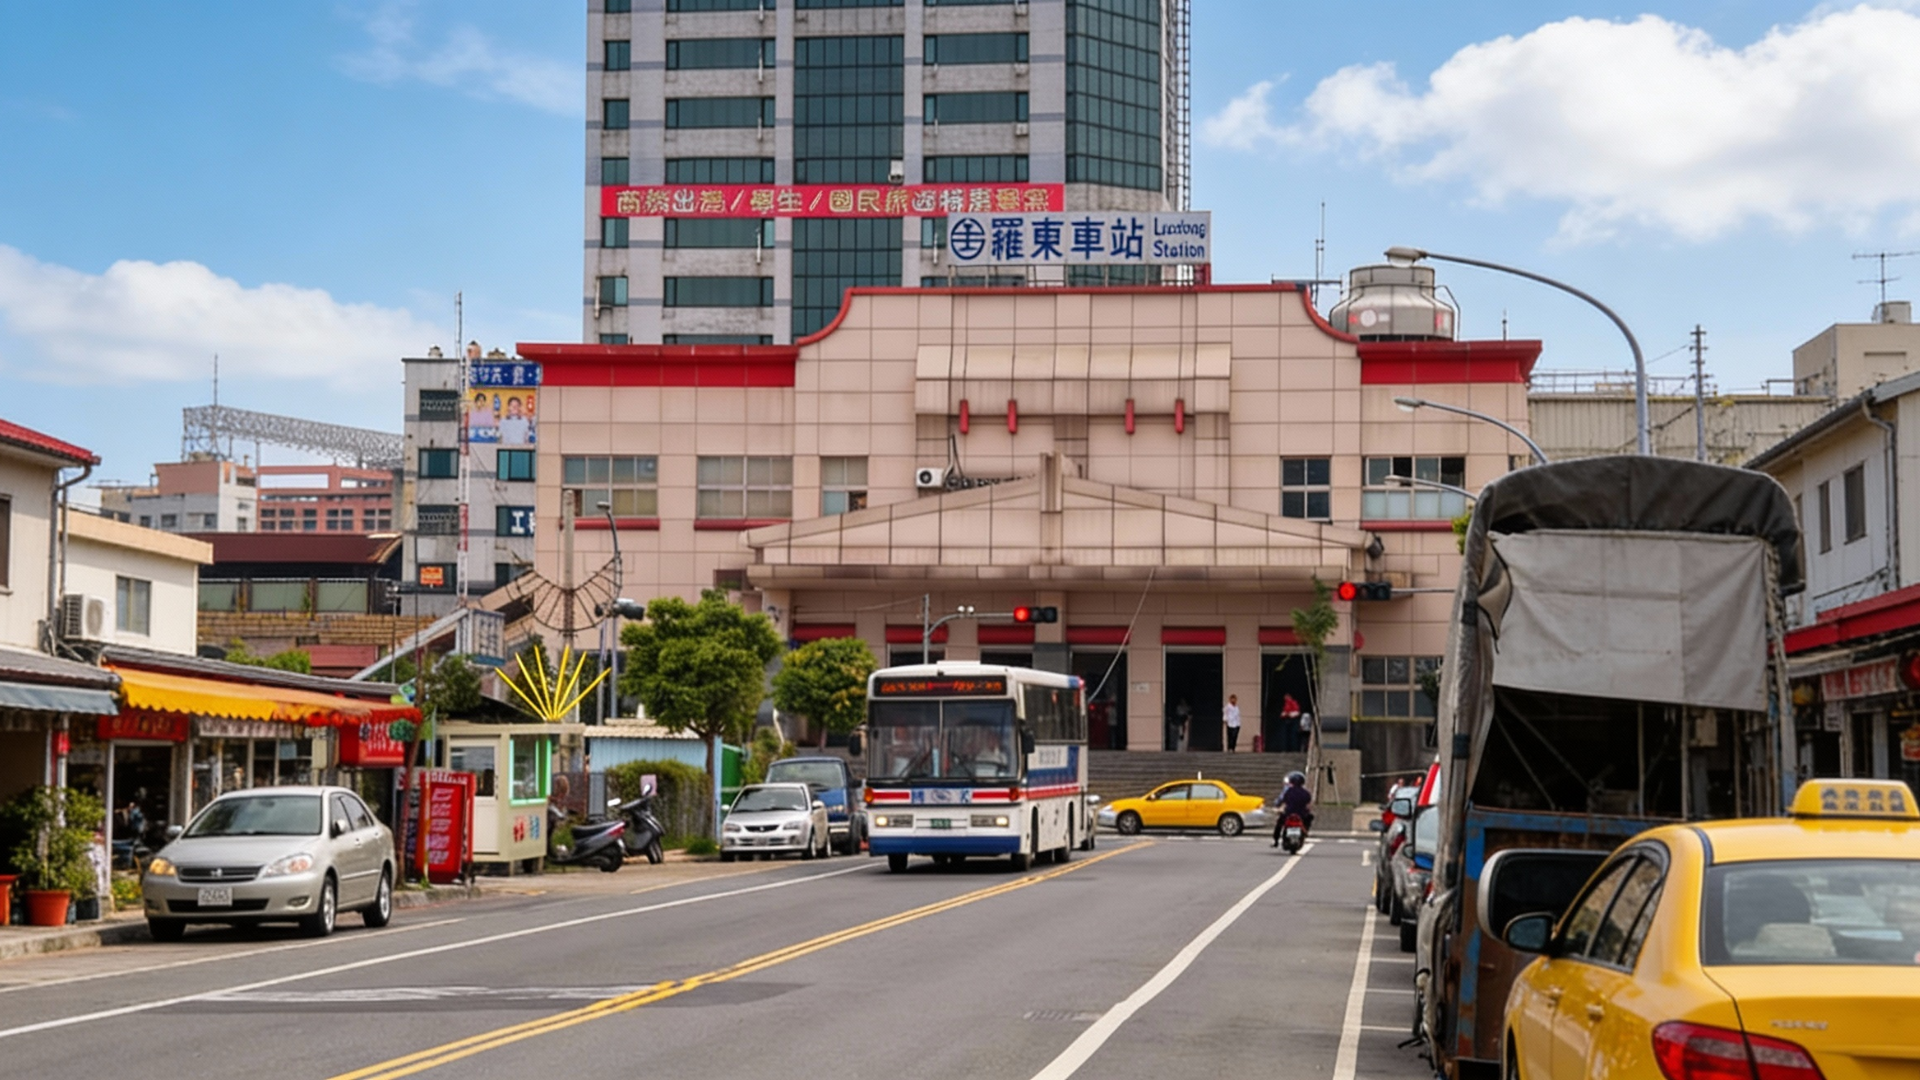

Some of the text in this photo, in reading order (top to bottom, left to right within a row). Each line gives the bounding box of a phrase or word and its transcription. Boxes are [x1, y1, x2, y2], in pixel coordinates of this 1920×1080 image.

[991, 216, 1144, 260] 羅東車站
[1153, 239, 1205, 258] Station
